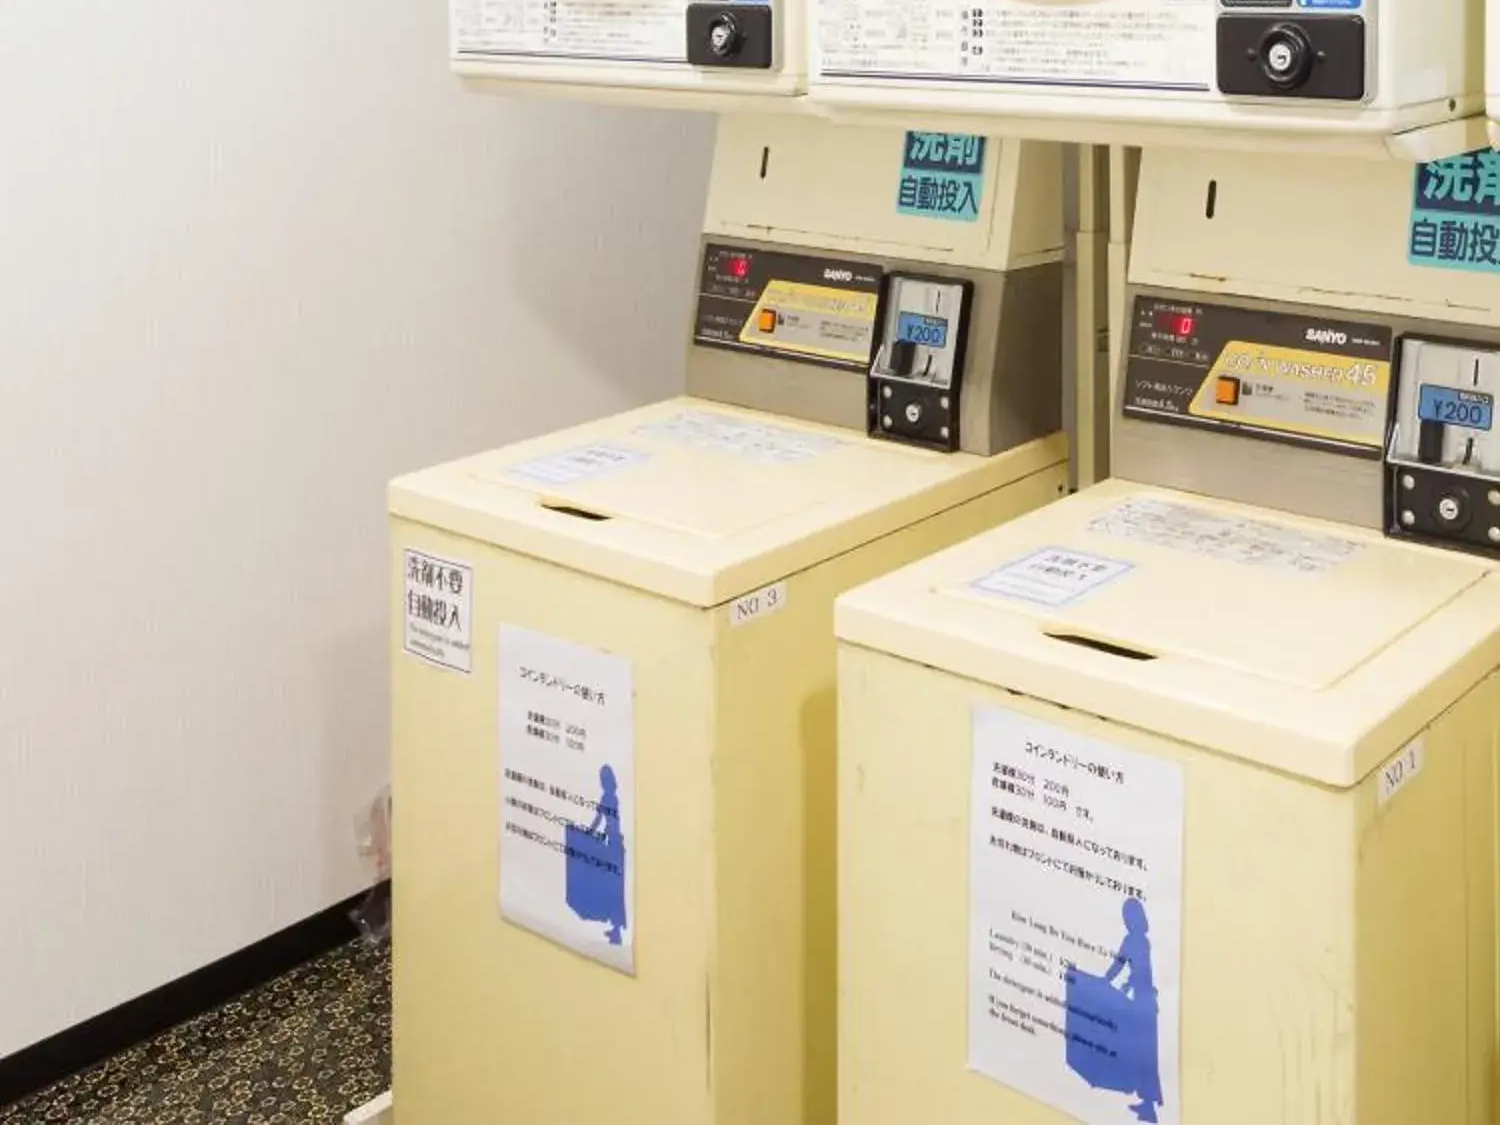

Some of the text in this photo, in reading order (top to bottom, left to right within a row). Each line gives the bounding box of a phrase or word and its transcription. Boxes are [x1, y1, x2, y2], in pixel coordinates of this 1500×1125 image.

[898, 175, 978, 214] 自動投入
[823, 268, 853, 282] SANYO
[1305, 328, 1347, 345] SANYO
[1345, 363, 1377, 386] 45
[1433, 399, 1482, 424] ¥200
[1024, 741, 1125, 785] コインランドリーの使い方
